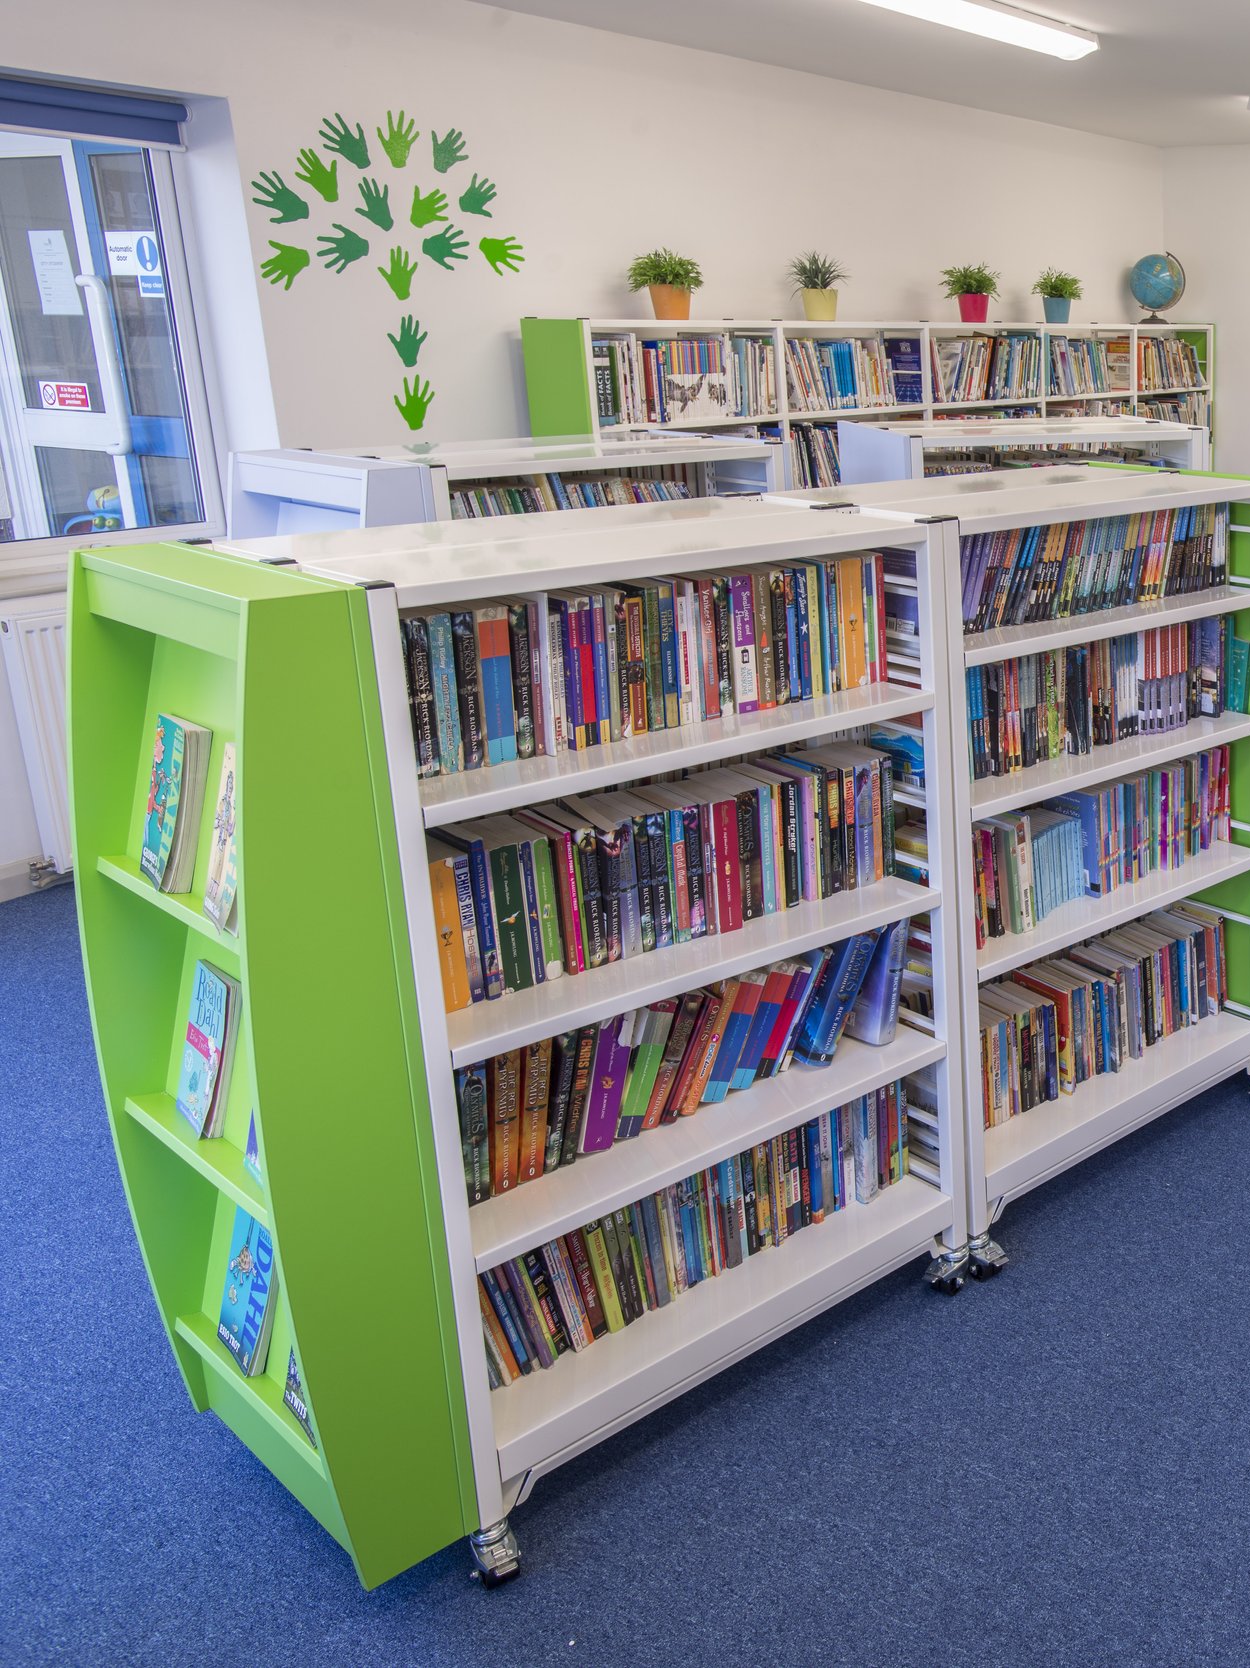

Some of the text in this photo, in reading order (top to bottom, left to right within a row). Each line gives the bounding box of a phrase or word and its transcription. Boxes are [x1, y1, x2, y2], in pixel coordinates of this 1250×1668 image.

[701, 589, 711, 619] Yankee
[740, 591, 752, 635] Swallows and
[661, 611, 669, 642] THIEVES
[704, 620, 712, 634] Girl
[735, 609, 745, 642] Amazons
[437, 627, 447, 669] Philip Ridley
[462, 632, 477, 680] JACKSON
[519, 635, 531, 673] JACKSON
[763, 657, 771, 676] Arthur
[415, 649, 430, 690] JACKSON
[721, 651, 731, 704] RICK RIORDAN
[778, 660, 787, 692] RIORDAN
[467, 696, 478, 752] RICK RIORDAN
[521, 686, 531, 744] RICK RIORDAN
[621, 690, 629, 724] RIORDAN
[421, 703, 432, 762] RICK RIORDAN
[845, 780, 855, 805] CHRIS
[871, 773, 881, 817] CHRIS RYAN
[743, 806, 754, 852] OLYMPUS
[788, 784, 798, 853] Jordan Stryker
[828, 783, 841, 872] CHRIS RYAN Hunted
[846, 806, 855, 825] RYAN
[653, 832, 666, 872] JACKSON
[674, 844, 687, 887] Crystal Mask
[847, 851, 855, 875] Money
[477, 864, 487, 900] INTRUDER
[457, 871, 479, 979] CHRIS RYAN Hostage
[481, 901, 489, 910] John
[644, 906, 652, 938] RIORDAN
[660, 904, 668, 933] RIORDAN
[693, 894, 701, 925] RIORDAN
[590, 900, 602, 952] RICK RIORDAN
[840, 950, 857, 992] MARK ATHENA
[846, 941, 871, 991] OLYMPUS
[197, 967, 223, 1014] Roald
[889, 993, 897, 1022] RIORDAN
[196, 1000, 218, 1039] Dahl
[701, 1005, 720, 1041] OLYMPUS
[824, 1006, 844, 1051] RICK RIORDAN
[498, 1069, 508, 1117] PYRAMID
[508, 1071, 516, 1112] THE RED
[528, 1056, 539, 1104] PYRAMID
[538, 1058, 547, 1099] THE RED
[561, 1056, 573, 1091] JACKSON
[570, 1039, 592, 1133] CHRIS RYAN Wildfire
[471, 1084, 483, 1133] OLYMPUS
[652, 1084, 667, 1115] RIORDAN
[530, 1132, 538, 1165] RIORDAN
[553, 1123, 562, 1156] RIORDAN
[502, 1144, 510, 1178] RIORDAN
[725, 1196, 733, 1214] louis
[727, 1166, 735, 1209] Cardturner
[801, 1168, 811, 1205] AVENGER!
[593, 1231, 603, 1251] frozen
[600, 1258, 608, 1271] time
[242, 1240, 273, 1350] DAHL
[581, 1270, 592, 1288] Heart
[540, 1299, 556, 1333] ONSLAUGHT
[218, 1321, 241, 1353] ESIO TROT
[289, 1391, 308, 1420] TWITS
